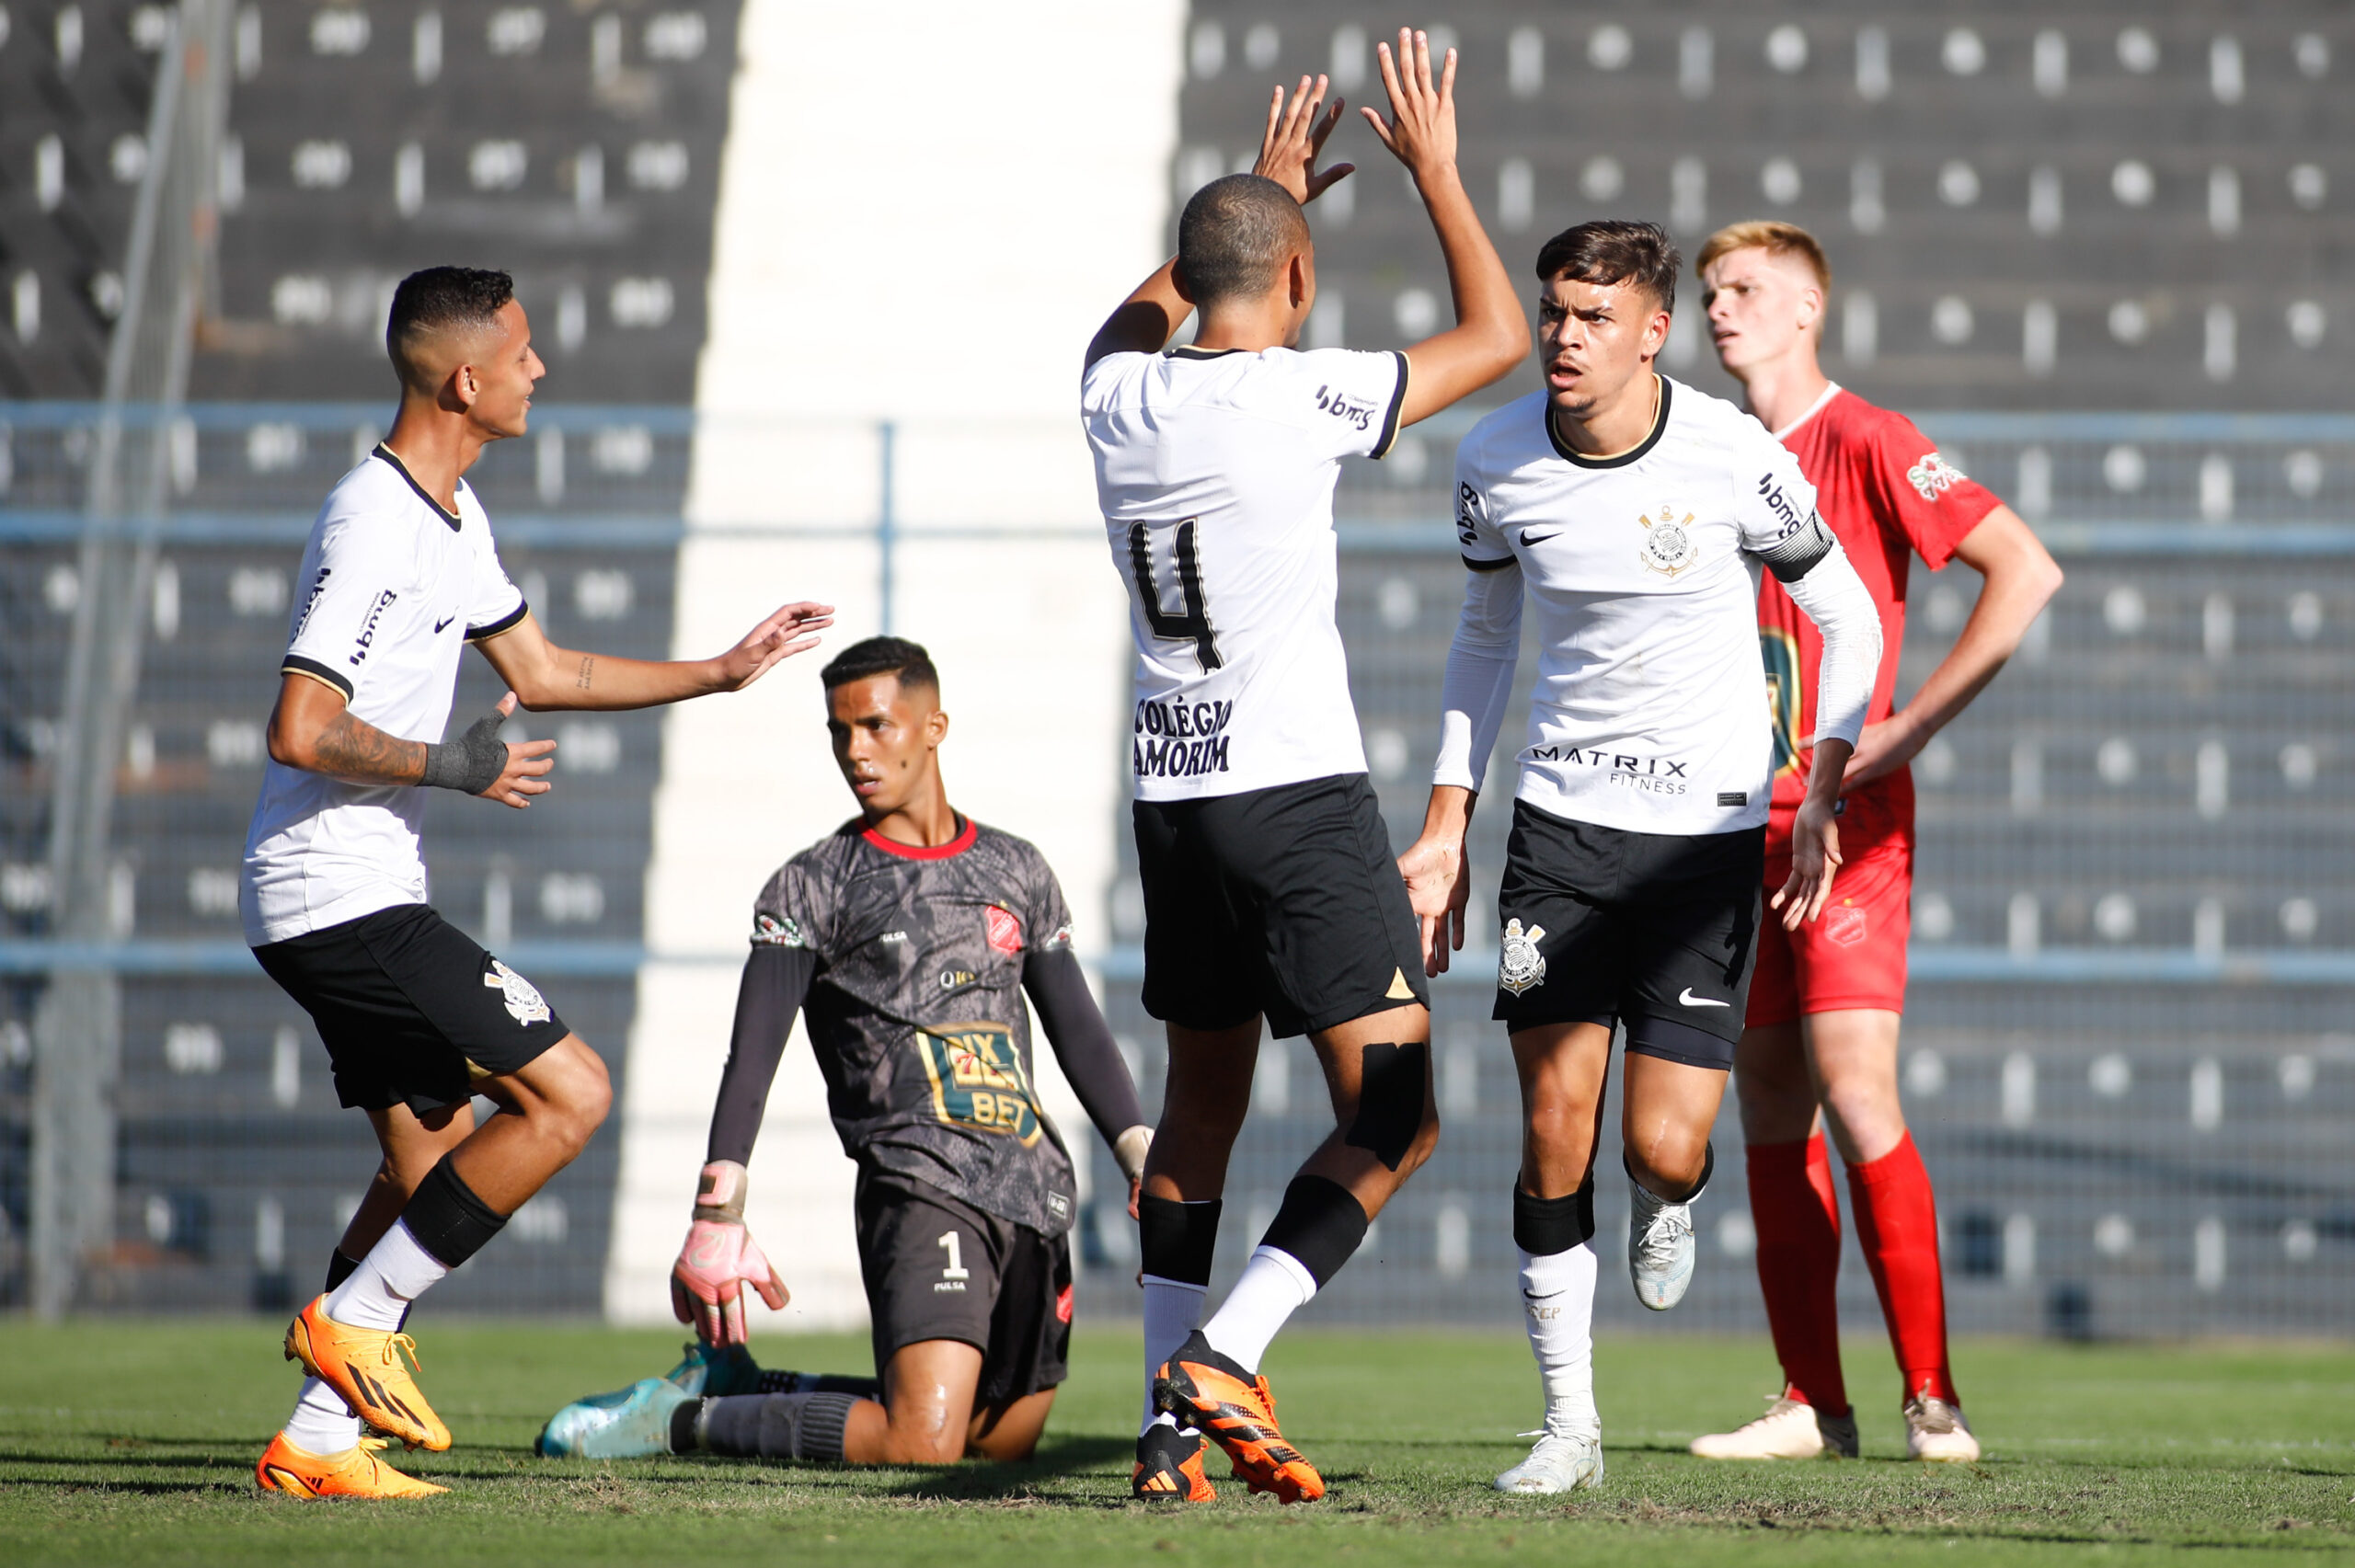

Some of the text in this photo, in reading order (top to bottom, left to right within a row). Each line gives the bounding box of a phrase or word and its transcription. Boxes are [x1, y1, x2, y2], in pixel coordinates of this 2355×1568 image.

[356, 589, 397, 649] bmg
[1128, 520, 1223, 676] 4
[1134, 695, 1233, 738] COLÉGIO
[1133, 735, 1231, 777] AMORIM
[1533, 746, 1686, 778] MATRIX
[1609, 773, 1686, 795] FITNESS
[937, 1230, 970, 1279] 1
[934, 1281, 966, 1292] PULSA
